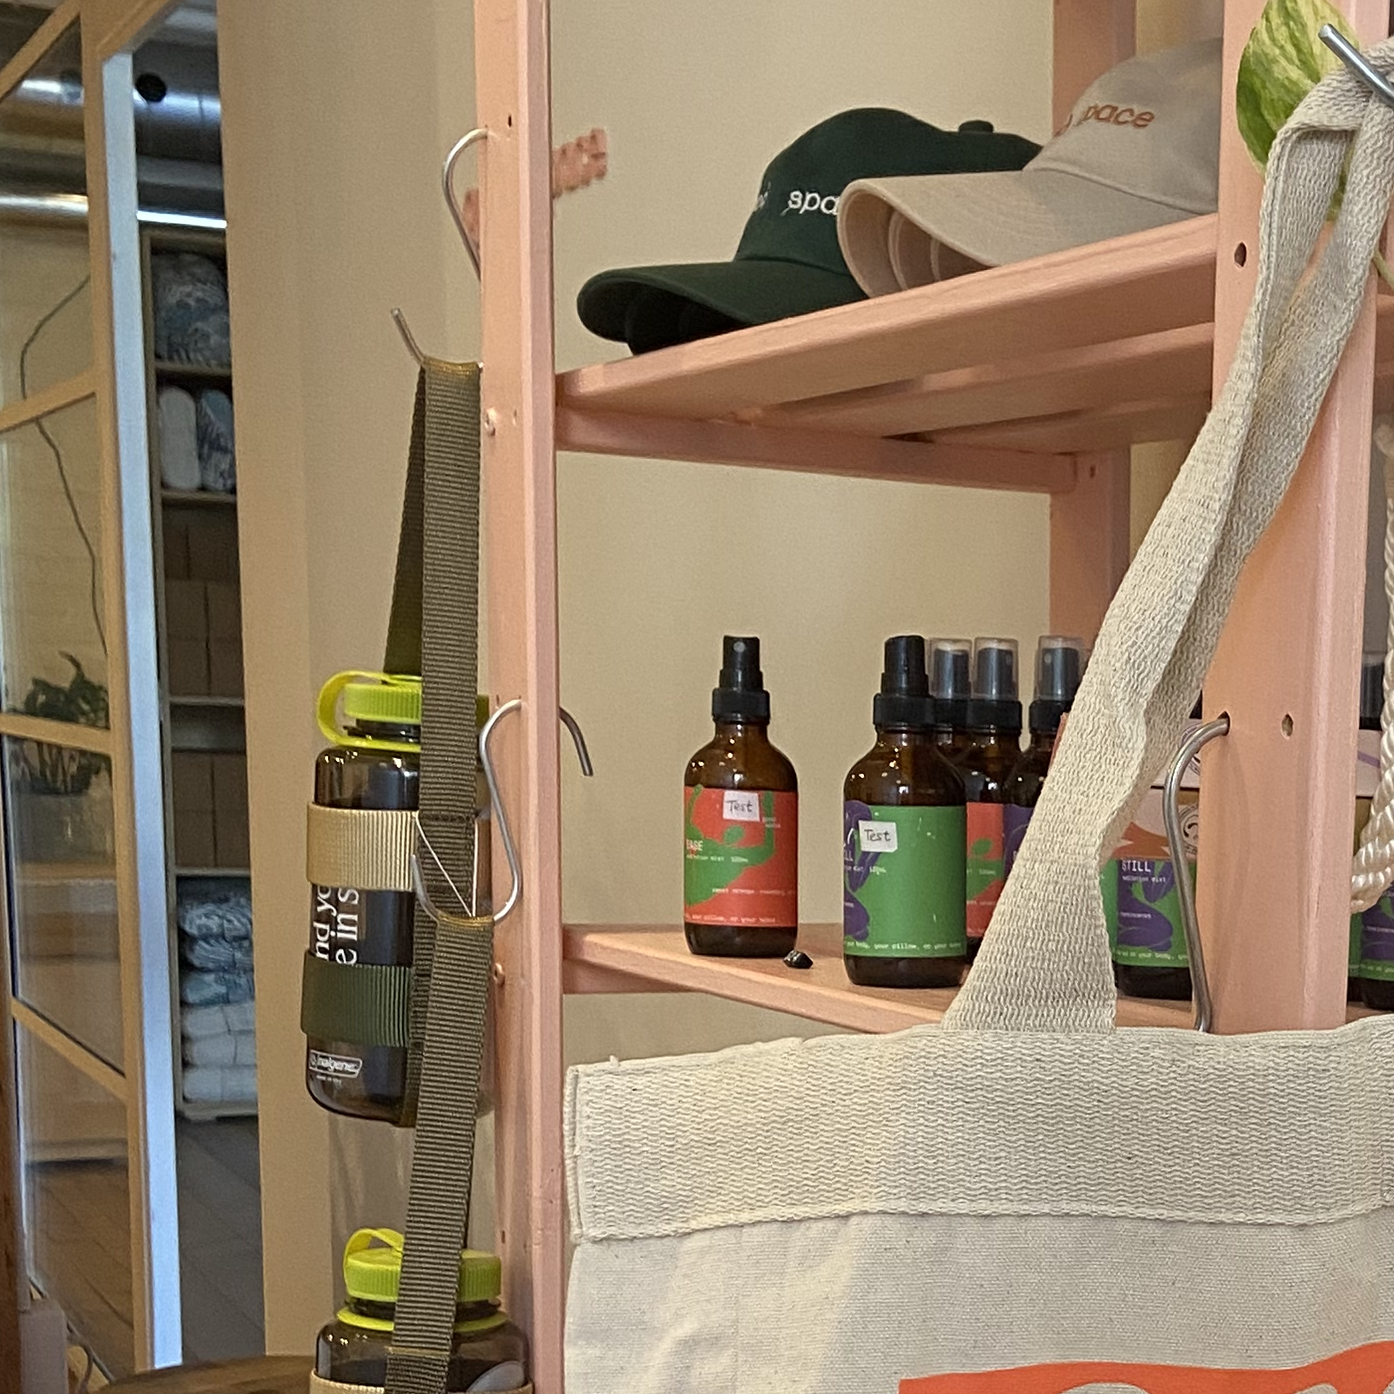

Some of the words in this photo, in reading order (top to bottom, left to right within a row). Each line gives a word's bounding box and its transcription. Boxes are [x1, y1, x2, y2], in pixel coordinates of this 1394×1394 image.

[725, 800, 753, 814] Test
[864, 829, 891, 842] Test
[330, 913, 359, 942] in
